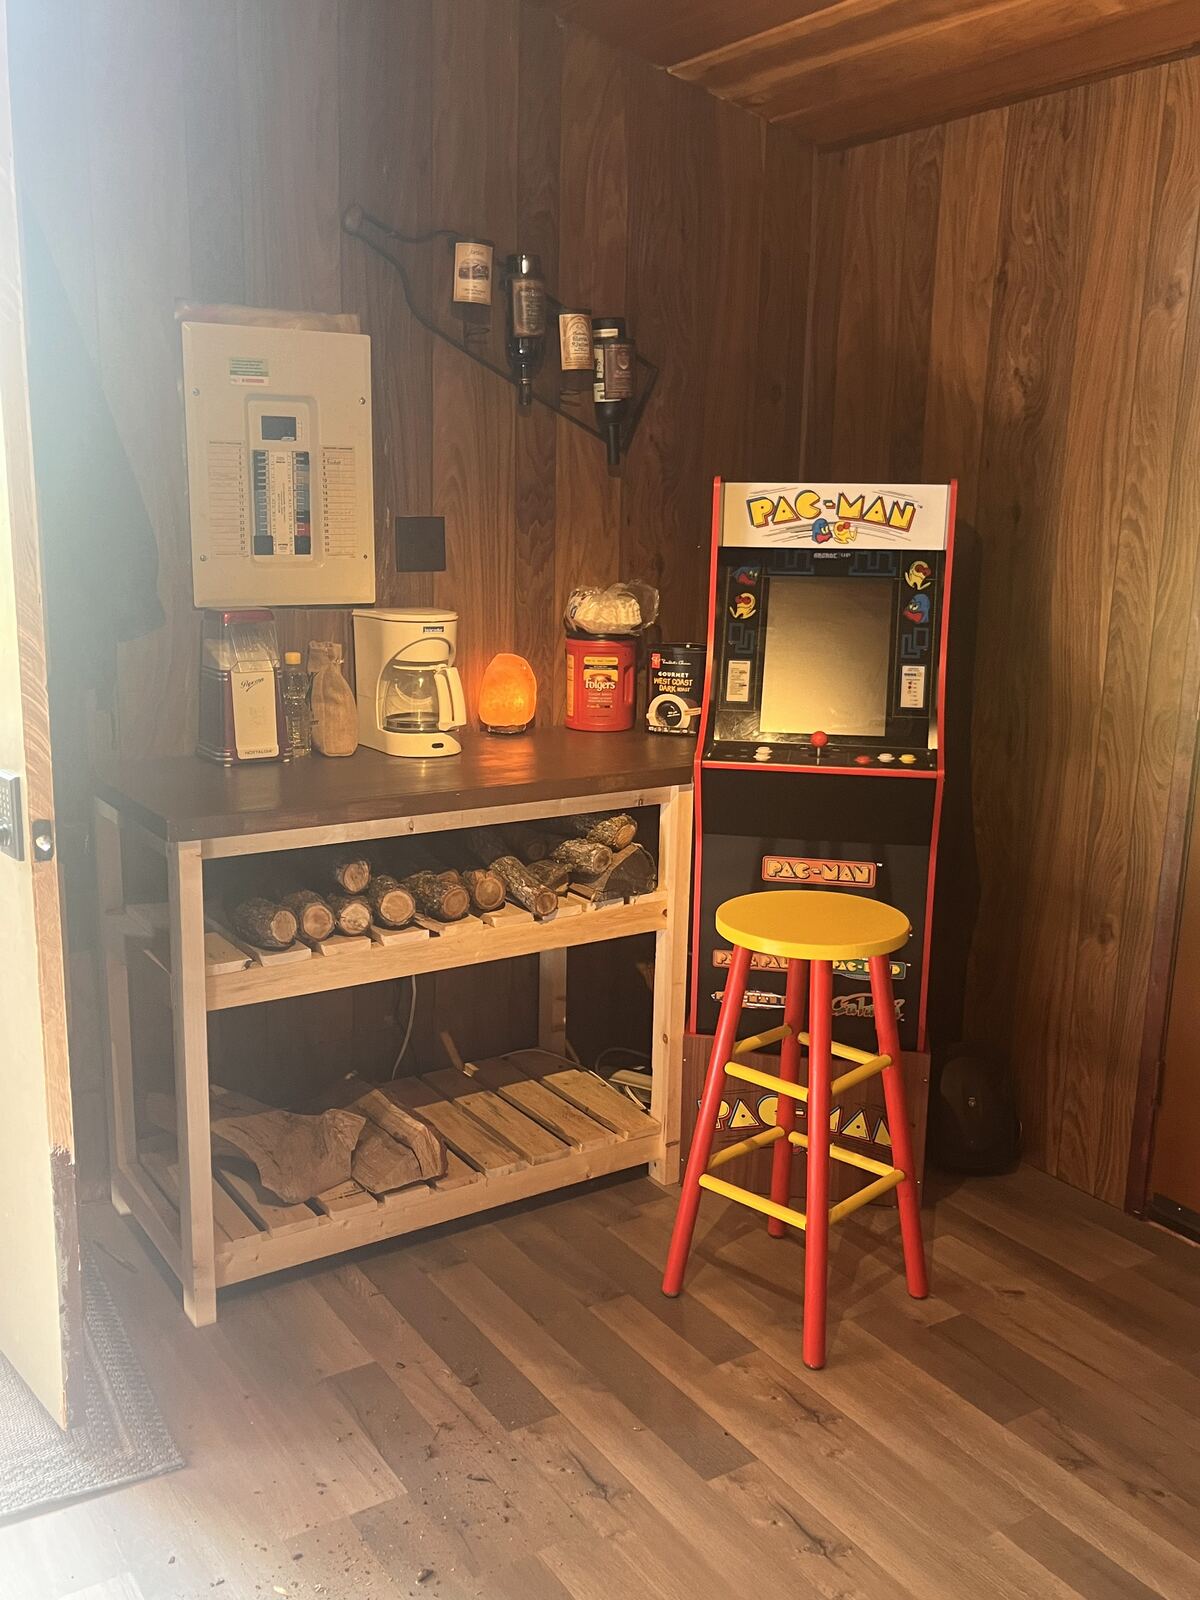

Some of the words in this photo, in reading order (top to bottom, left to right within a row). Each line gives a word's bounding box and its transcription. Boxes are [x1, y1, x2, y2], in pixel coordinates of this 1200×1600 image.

[746, 490, 916, 532] PAC-MAN
[585, 677, 616, 691] Folgers
[653, 677, 671, 685] WEST
[671, 678, 693, 686] COAST
[659, 684, 676, 693] DARK
[767, 860, 870, 883] PAC-MAN
